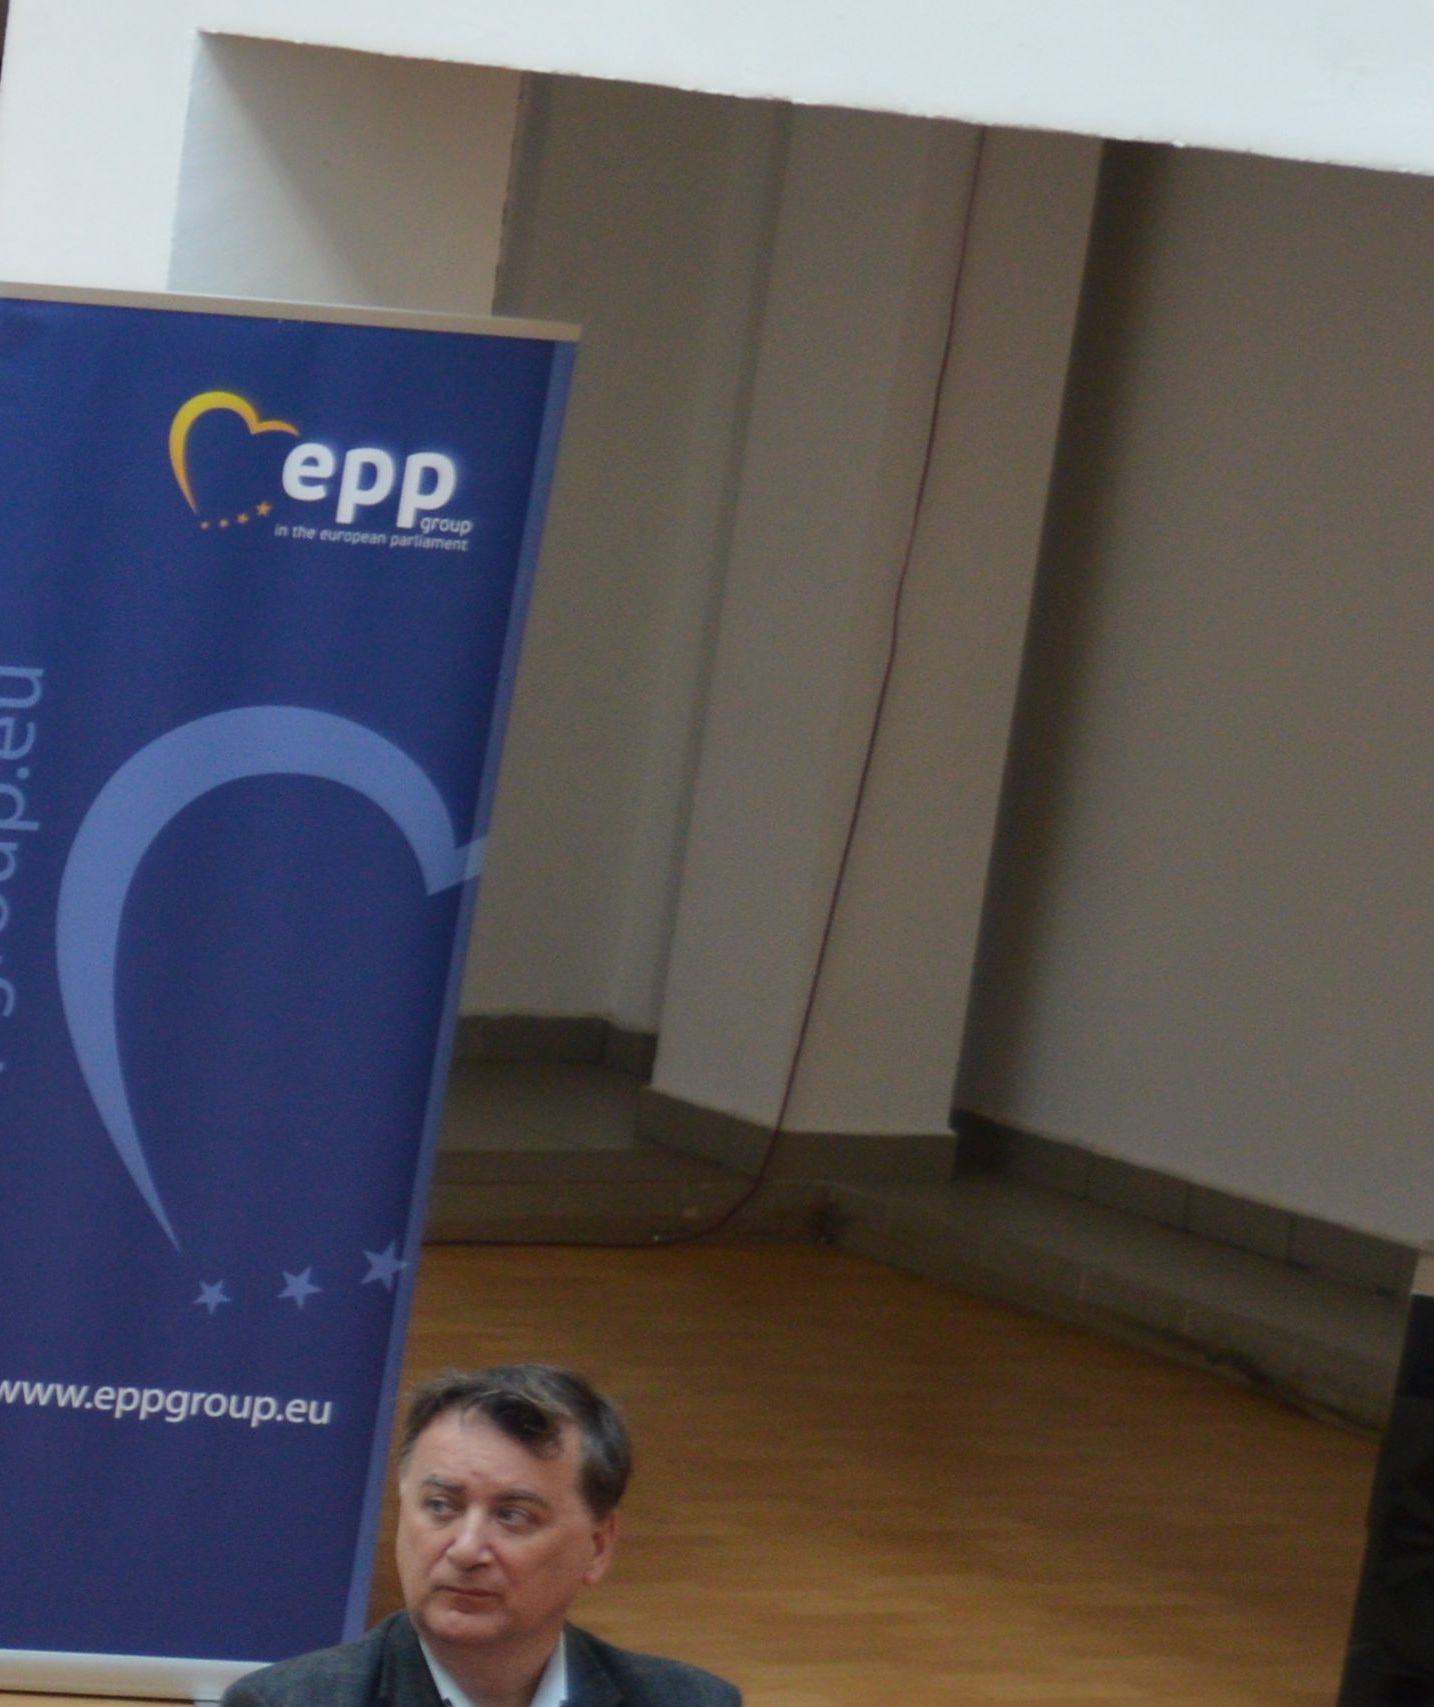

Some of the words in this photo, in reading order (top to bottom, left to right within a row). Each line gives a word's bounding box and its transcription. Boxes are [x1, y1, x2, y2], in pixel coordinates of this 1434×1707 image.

[282, 442, 456, 528] epp
[274, 524, 289, 537] in
[292, 525, 316, 539] the
[320, 530, 386, 545] european
[390, 532, 469, 551] parliament
[419, 517, 473, 535] group
